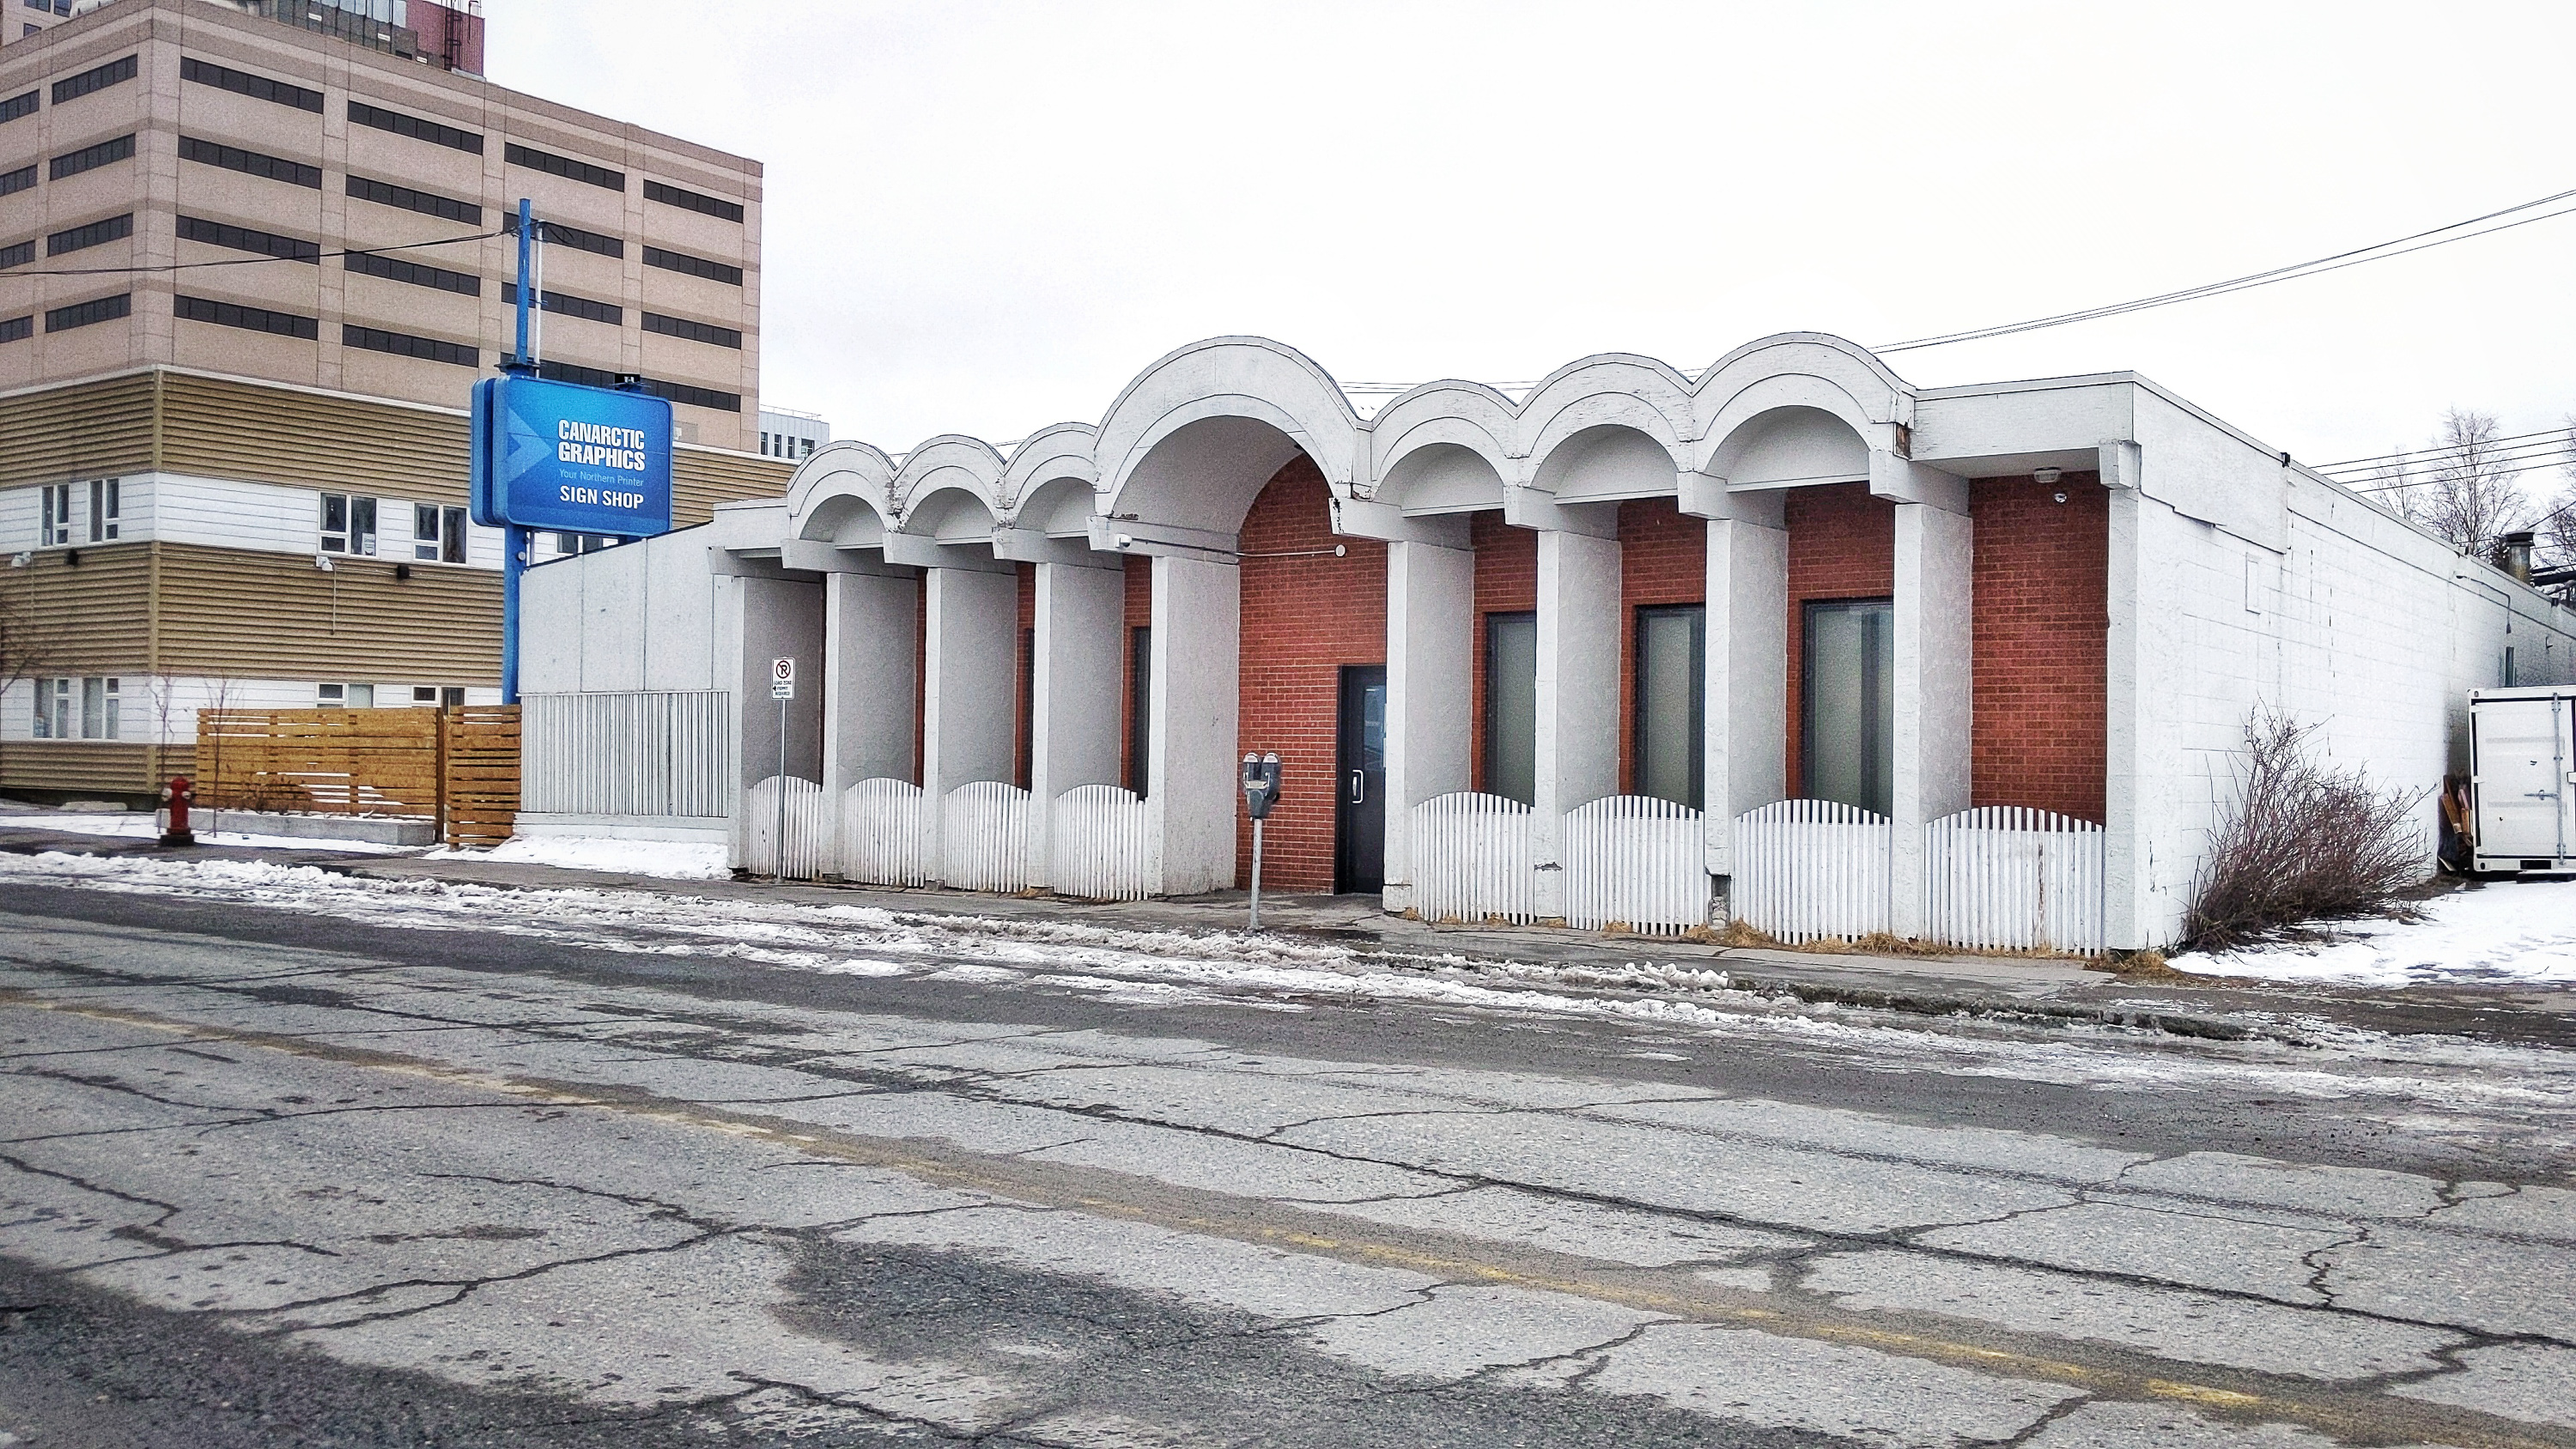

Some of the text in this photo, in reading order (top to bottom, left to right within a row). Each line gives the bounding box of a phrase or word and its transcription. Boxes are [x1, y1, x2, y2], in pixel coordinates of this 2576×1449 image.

[558, 419, 645, 450] CANARCTIC
[558, 441, 646, 471] GRAPHICS
[559, 469, 644, 487] Your Northern Printer
[560, 485, 644, 509] SIGN SHOP
